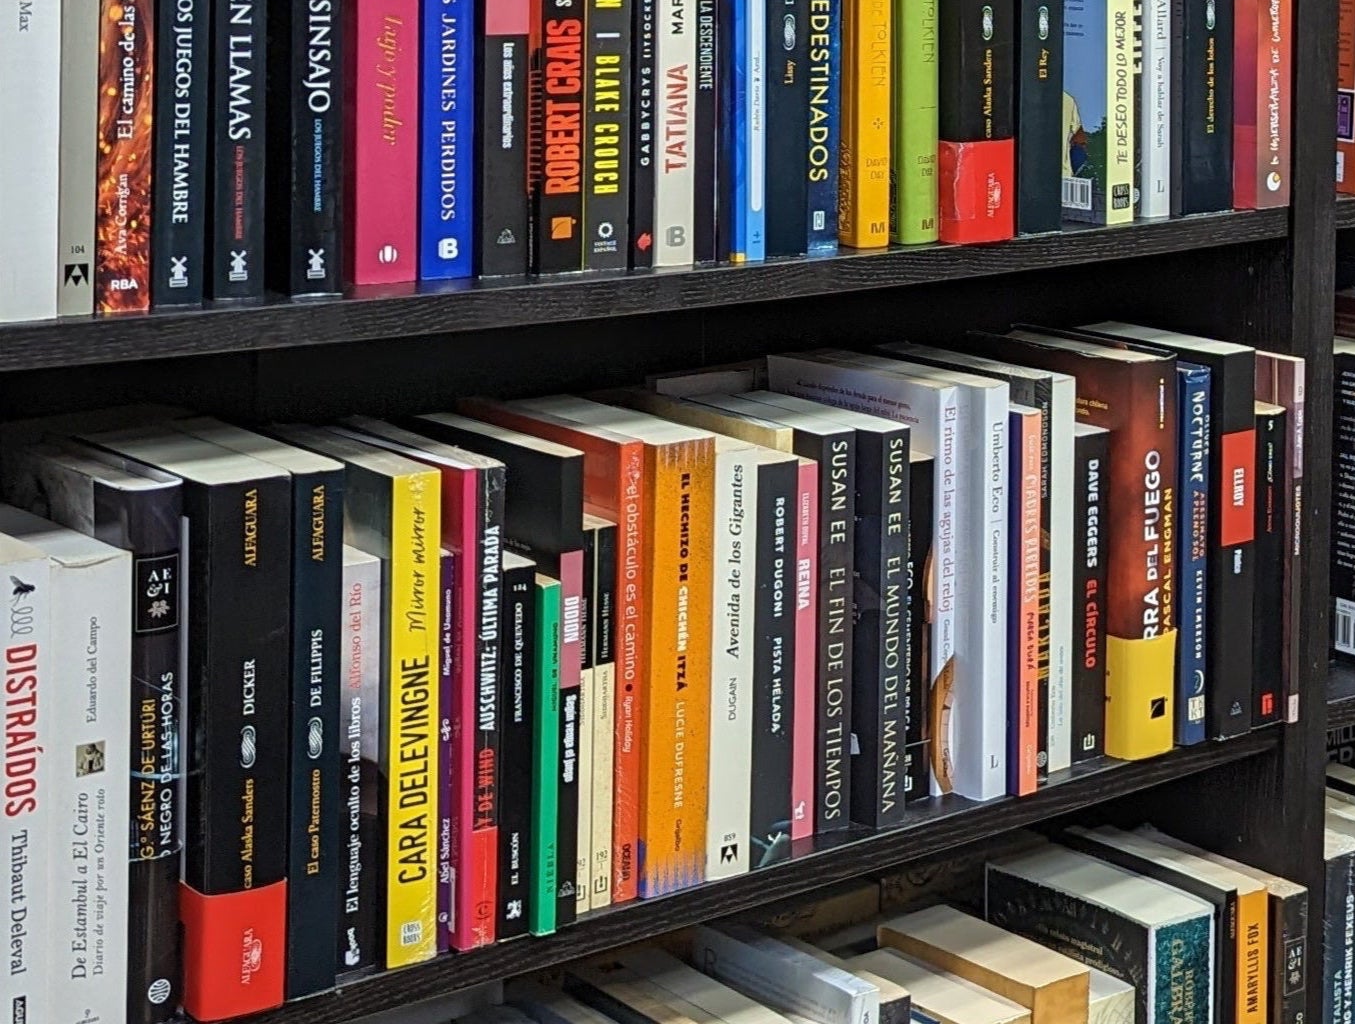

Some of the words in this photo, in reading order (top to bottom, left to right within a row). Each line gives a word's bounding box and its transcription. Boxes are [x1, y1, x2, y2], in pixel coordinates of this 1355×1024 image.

[19, 2, 33, 32] Max
[174, 27, 194, 98] JUEGOS
[229, 35, 252, 140] LLAMAS
[303, 0, 331, 113] SINSAJO
[441, 13, 456, 112] JARDINES
[546, 18, 581, 94] CRAIS
[594, 54, 620, 112] BLAKE
[174, 103, 190, 139] DEL
[545, 99, 580, 195] ROBERT
[665, 63, 688, 174] TATIANA
[172, 143, 189, 224] HAMBRE
[441, 120, 456, 221] PERDIDOS
[594, 123, 619, 194] CROUCH
[729, 464, 744, 536] Gigantes
[831, 441, 848, 511] SUSAN
[1087, 458, 1099, 502] DAVE
[1144, 450, 1161, 541] FUEGO
[1233, 467, 1245, 507] ELLROY
[728, 543, 741, 564] los
[830, 520, 846, 544] EE
[1086, 506, 1098, 569] EGGERS
[1163, 487, 1173, 564] ENGMAN
[728, 572, 740, 591] de
[828, 568, 845, 591] EL
[726, 587, 742, 659] Avenida
[828, 596, 844, 635] FIN
[243, 659, 255, 716] DICKER
[827, 642, 844, 670] DE
[5, 643, 43, 817] DISTRAÍDOS
[400, 655, 429, 808] DELEVINGNE
[826, 679, 842, 718] LOS
[824, 723, 842, 820] TIEMPOS
[11, 829, 28, 899] Thibaut
[398, 813, 427, 884] CARA
[10, 906, 27, 976] Deleval
[1247, 922, 1259, 946] FOX
[1246, 948, 1259, 1013] AMARYLLIS
